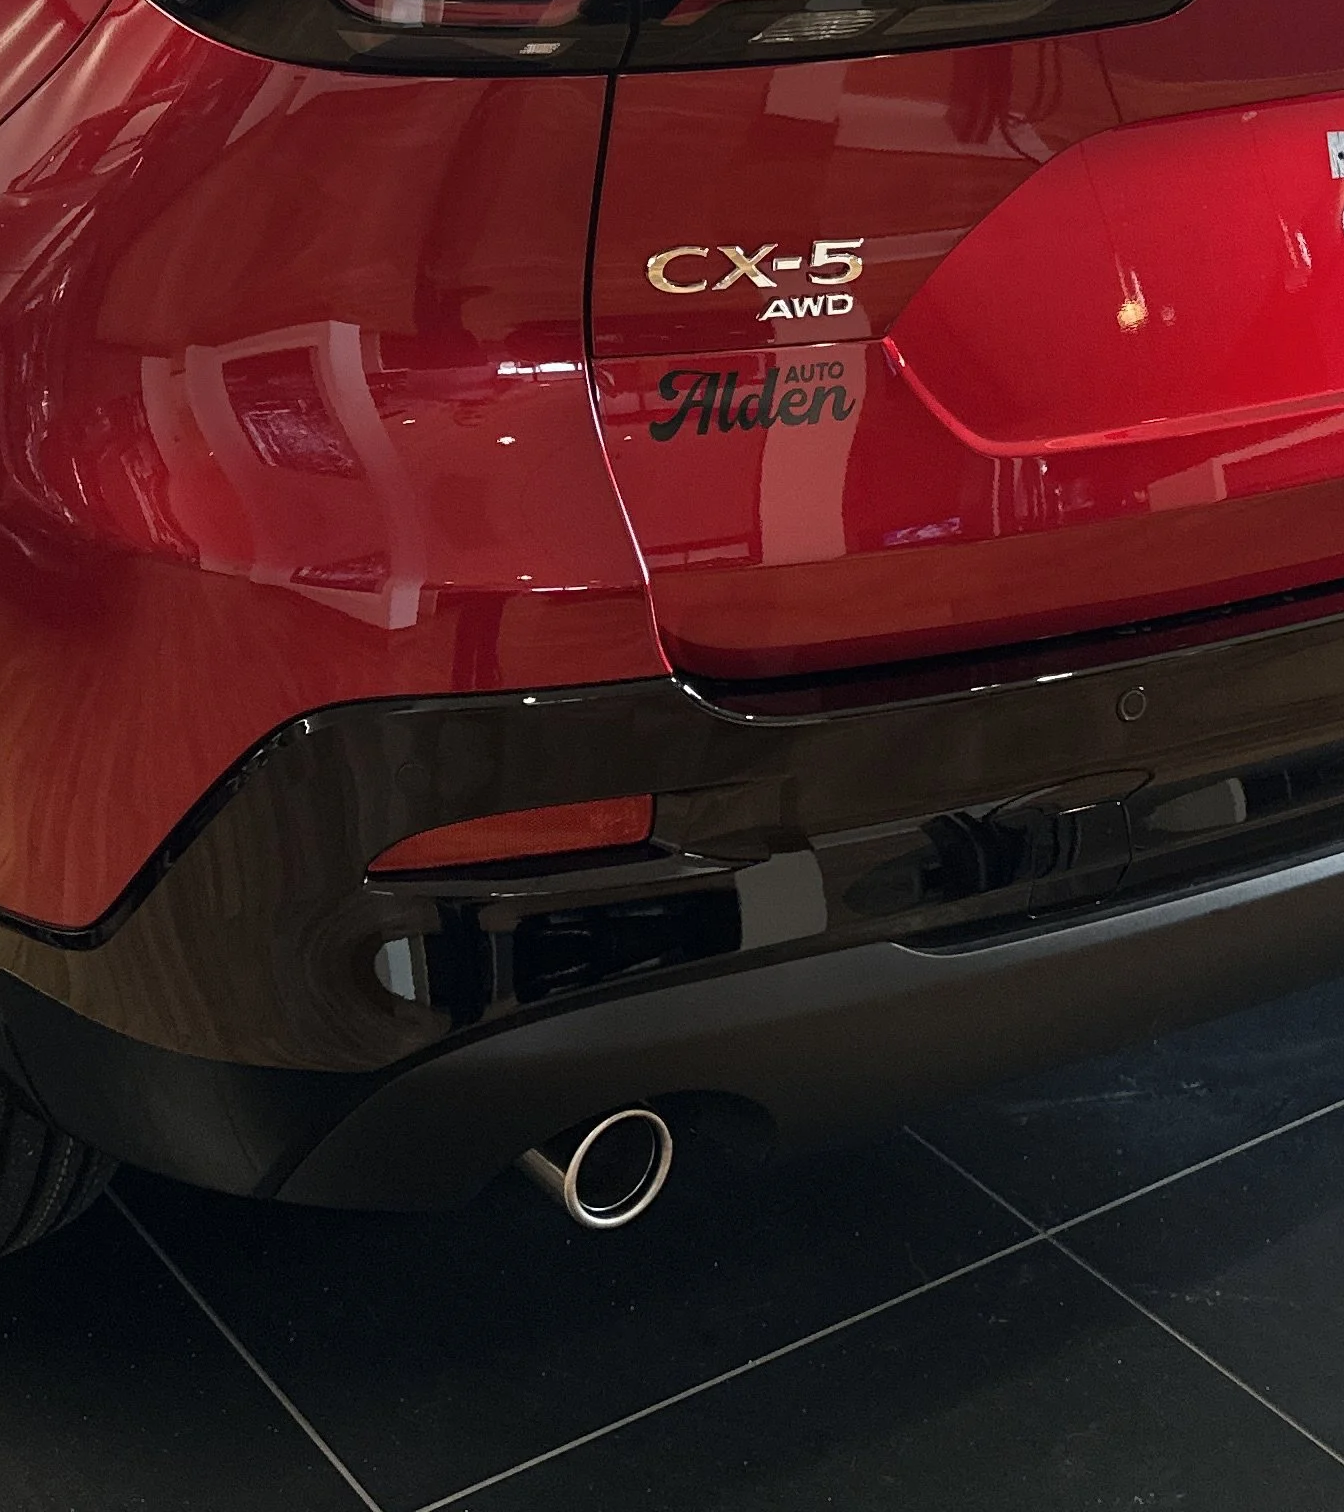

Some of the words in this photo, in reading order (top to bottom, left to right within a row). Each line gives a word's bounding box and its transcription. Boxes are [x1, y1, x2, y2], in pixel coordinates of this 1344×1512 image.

[646, 238, 865, 294] CX-5
[758, 293, 855, 322] AWD
[784, 361, 845, 384] AUTO
[650, 367, 857, 442] Alden
